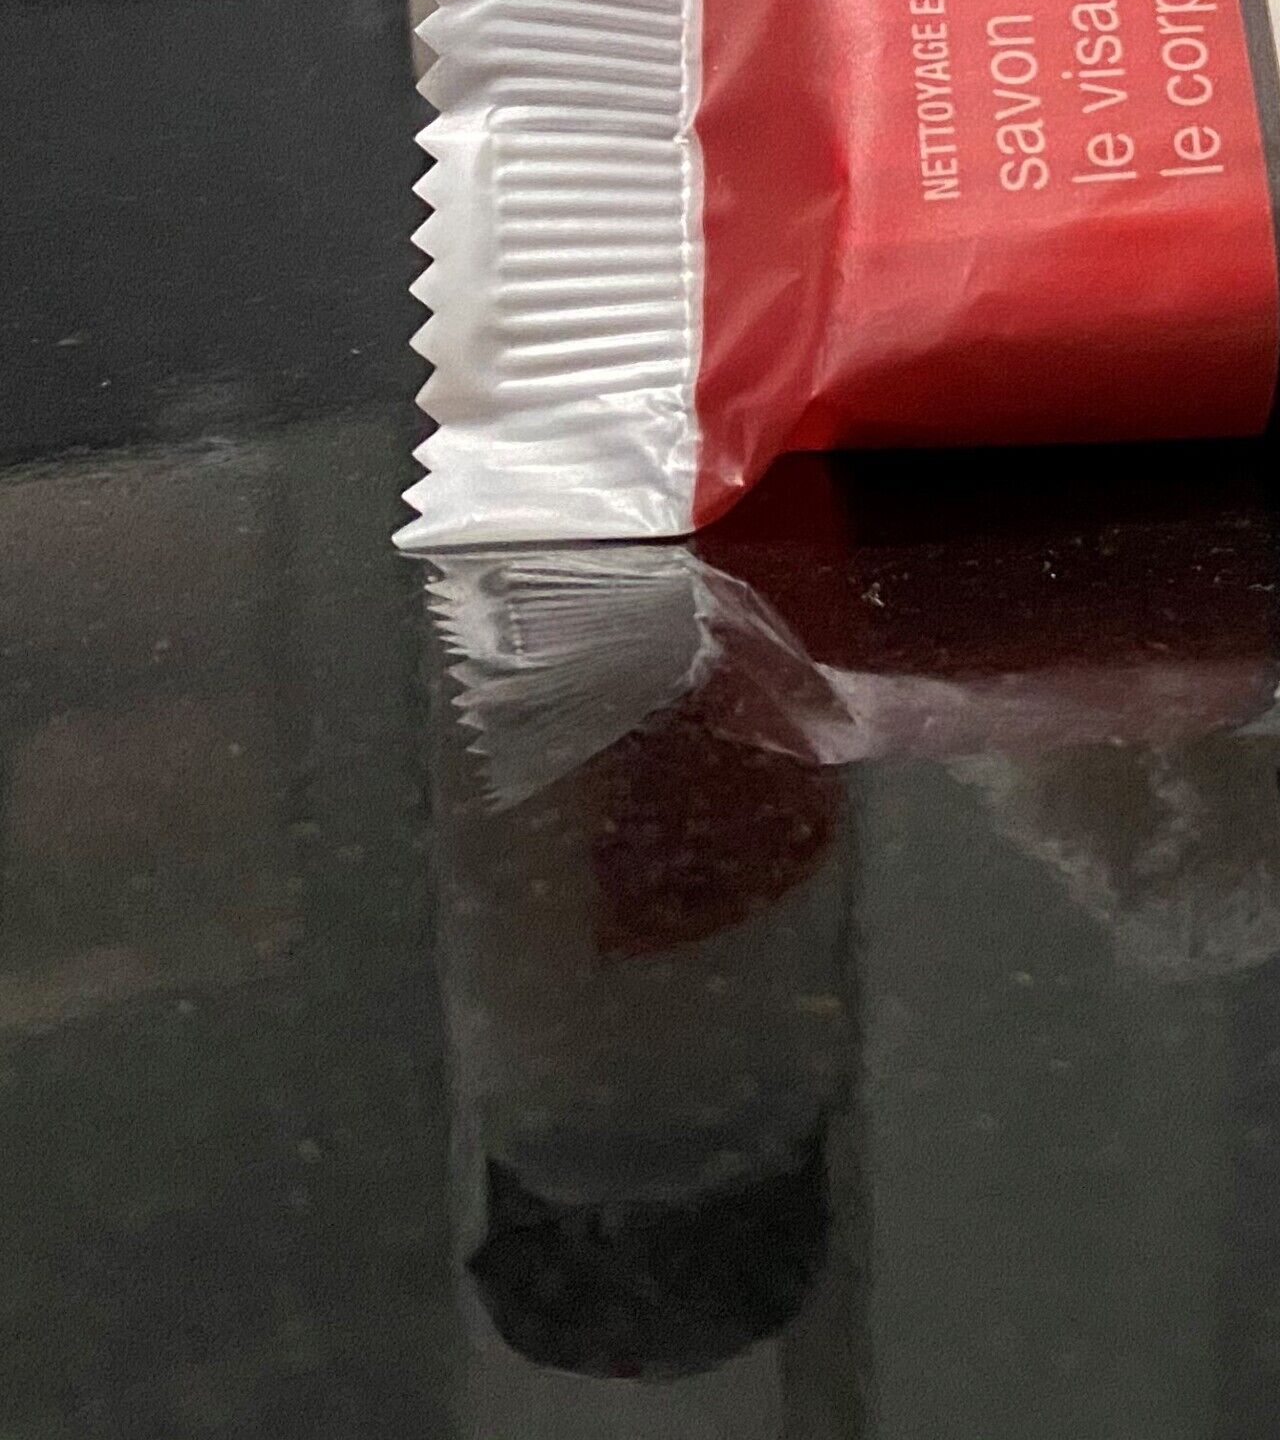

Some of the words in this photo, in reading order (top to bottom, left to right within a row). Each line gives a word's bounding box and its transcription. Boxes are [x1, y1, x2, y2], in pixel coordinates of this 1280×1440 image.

[910, 22, 961, 201] NETTOYAGE
[986, 14, 1049, 191] savon
[1071, 130, 1137, 183] le
[1160, 125, 1224, 176] le
